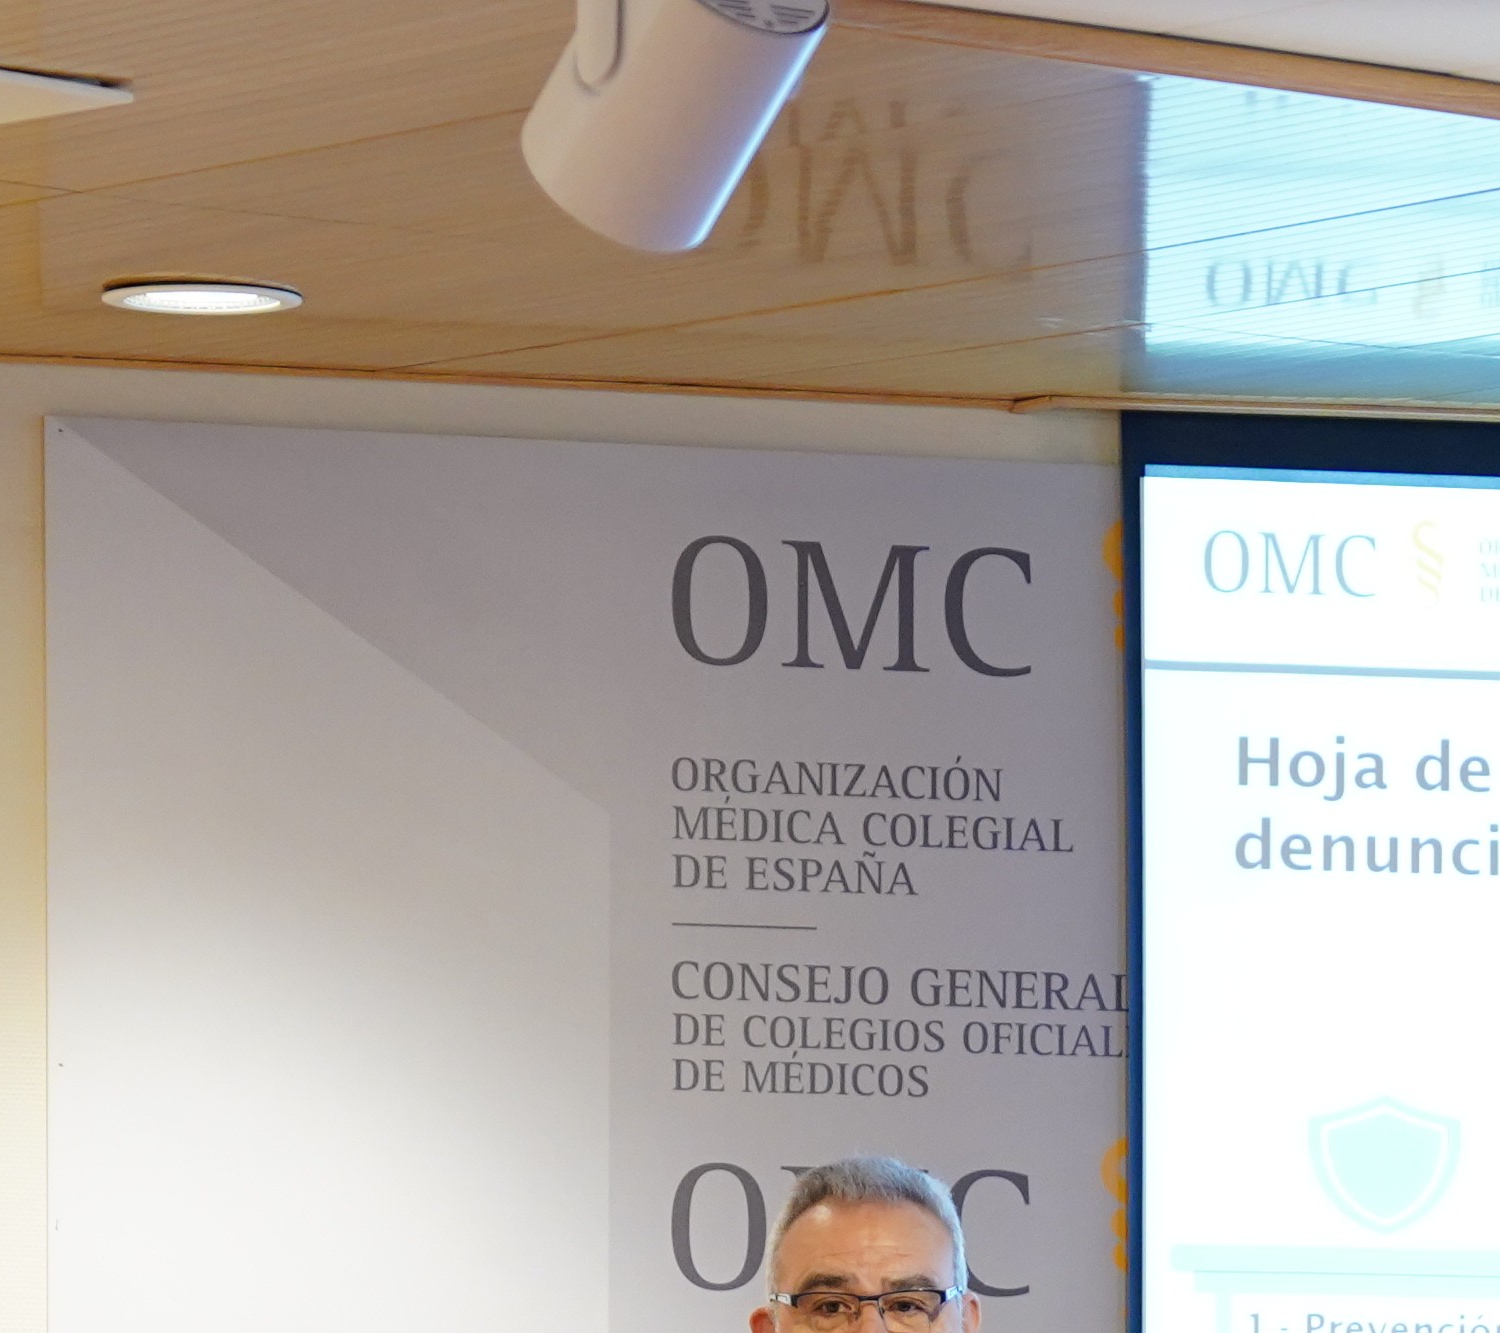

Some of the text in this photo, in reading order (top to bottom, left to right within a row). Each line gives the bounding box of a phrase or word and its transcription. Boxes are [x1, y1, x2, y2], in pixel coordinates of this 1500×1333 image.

[1203, 529, 1378, 598] OMC
[671, 534, 1032, 678] OMC
[671, 757, 1003, 802] ORGANIZACIÓN
[1235, 735, 1388, 800] Hoja
[1414, 740, 1492, 794] de
[673, 796, 1074, 853] MÉDICA COLEGIAL
[674, 850, 918, 896] DE ESPAÑA
[671, 960, 890, 1006] CONSEJO
[674, 1013, 1128, 1058] DE COLEGIOS OFICIAL
[674, 1050, 930, 1098] DE MÉDICOS
[670, 1161, 1031, 1297] OC
